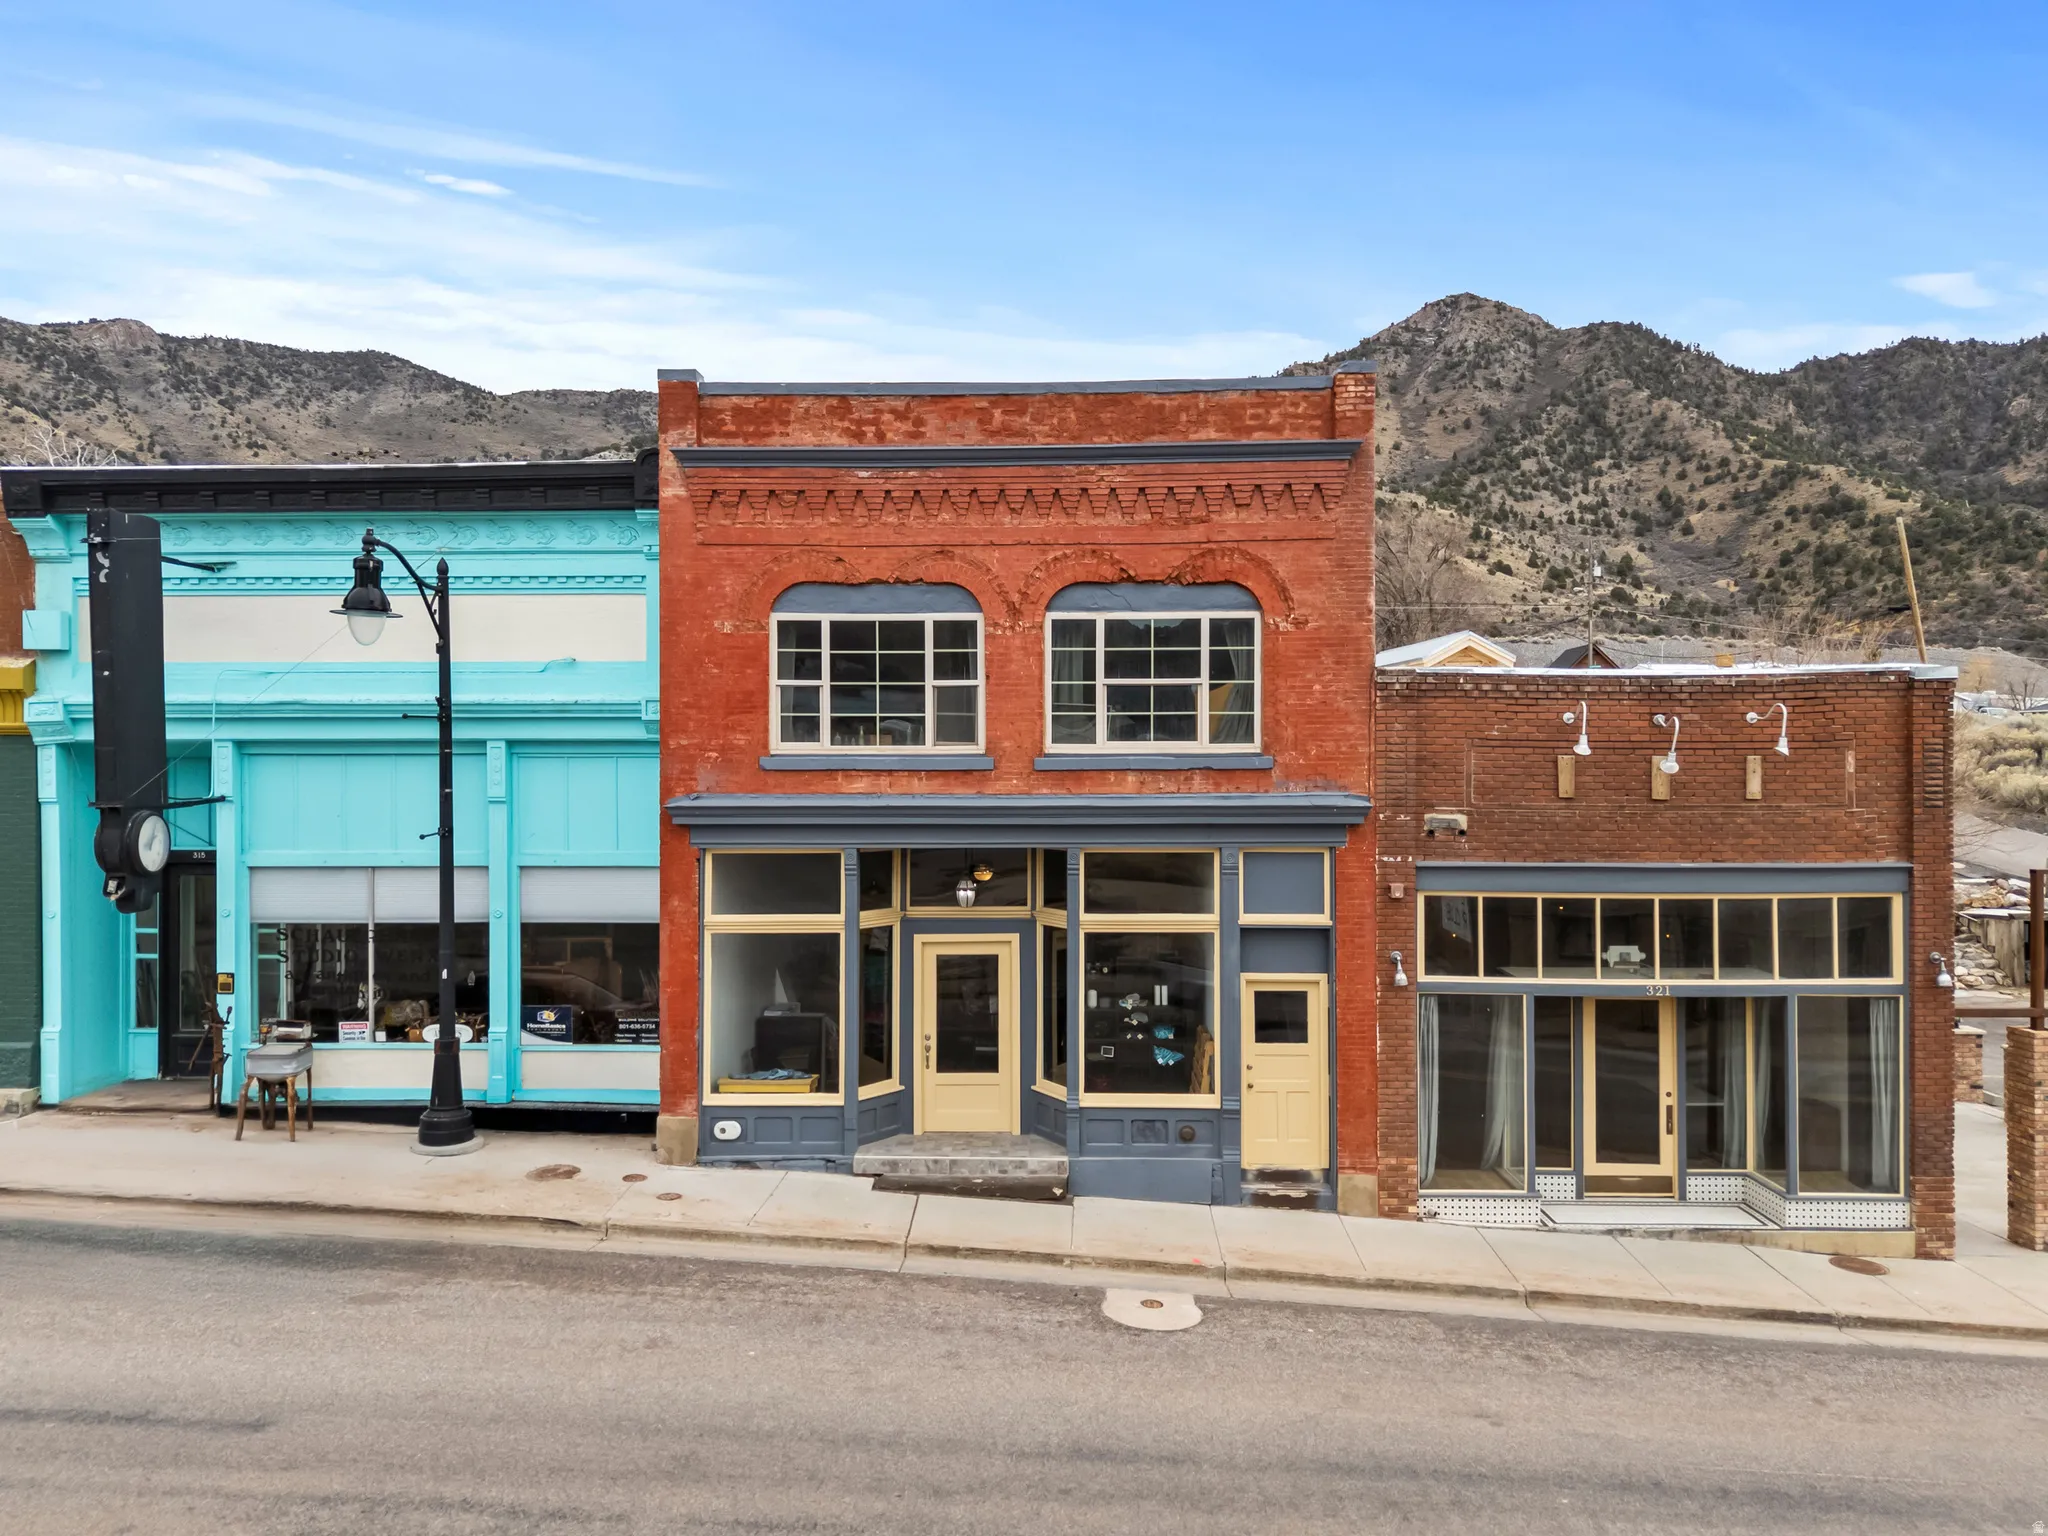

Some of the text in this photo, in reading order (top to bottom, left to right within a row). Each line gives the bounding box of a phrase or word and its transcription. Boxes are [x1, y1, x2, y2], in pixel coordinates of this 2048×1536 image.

[192, 851, 206, 859] 315
[277, 950, 357, 964] STUDIO
[1646, 985, 1671, 996] 321
